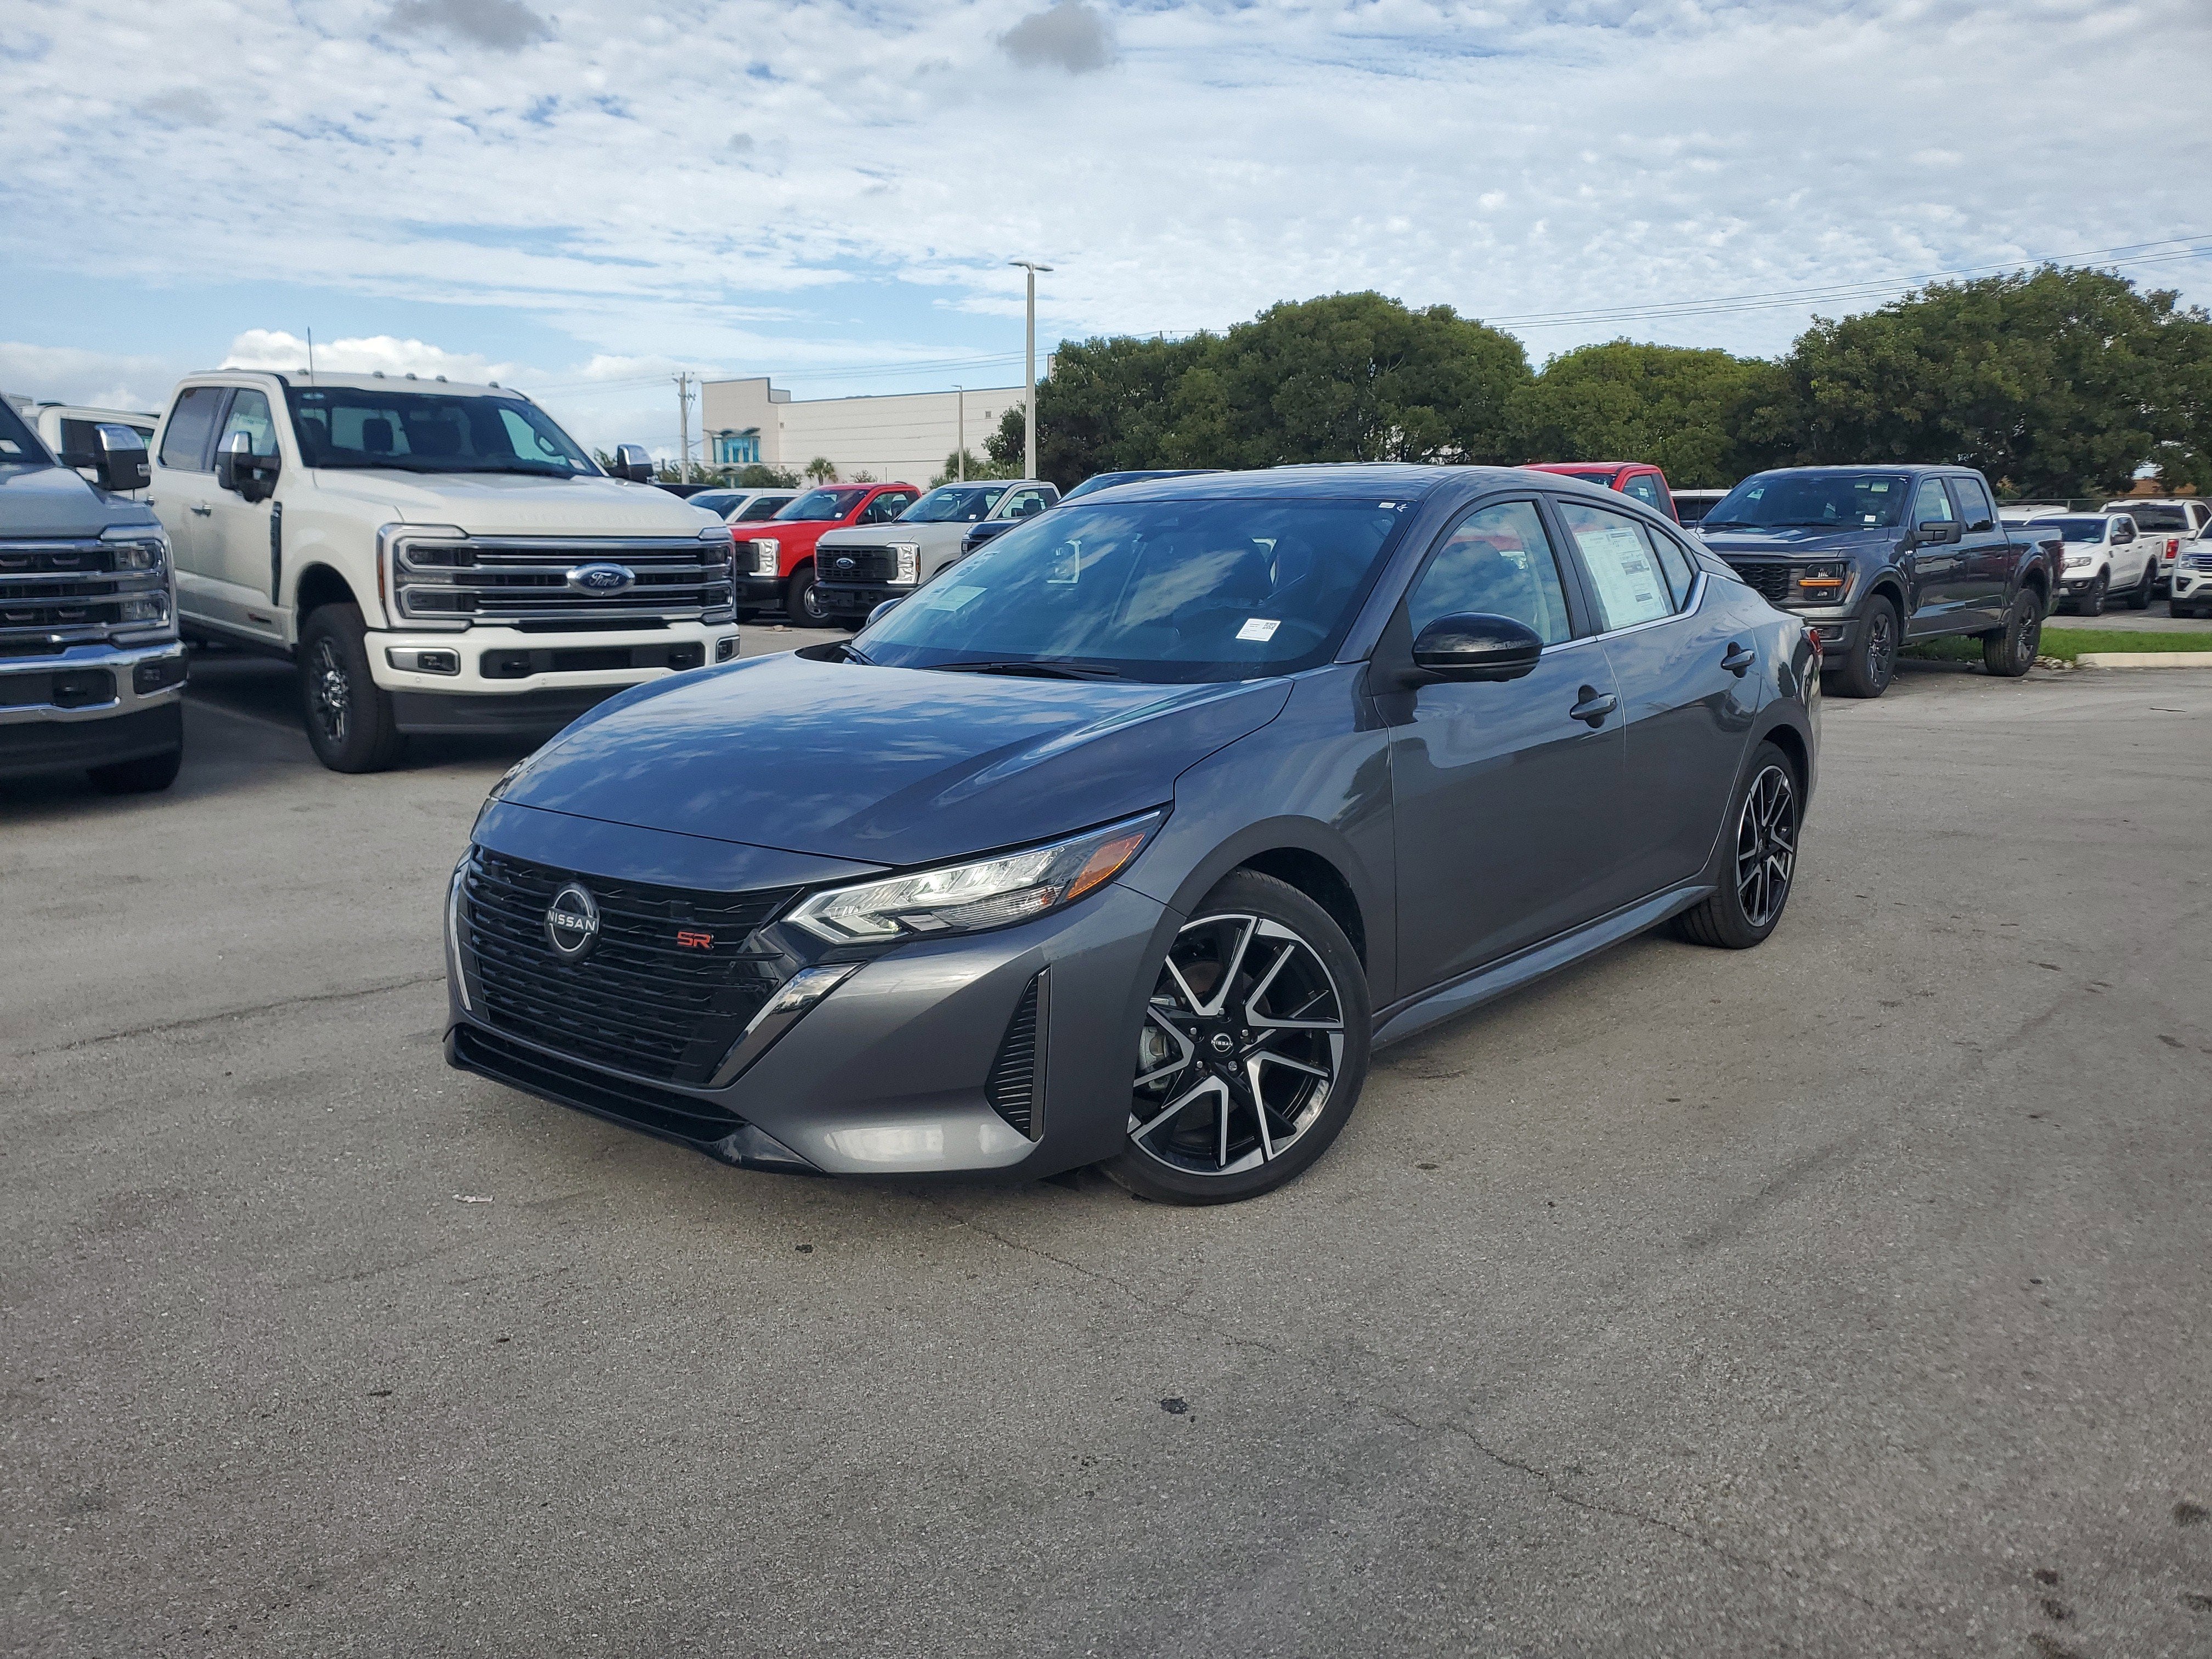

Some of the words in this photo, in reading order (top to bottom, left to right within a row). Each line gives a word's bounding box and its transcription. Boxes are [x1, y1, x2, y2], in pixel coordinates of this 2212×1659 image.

[589, 572, 619, 586] Ford
[548, 910, 596, 931] NISSAN
[677, 931, 712, 949] SR
